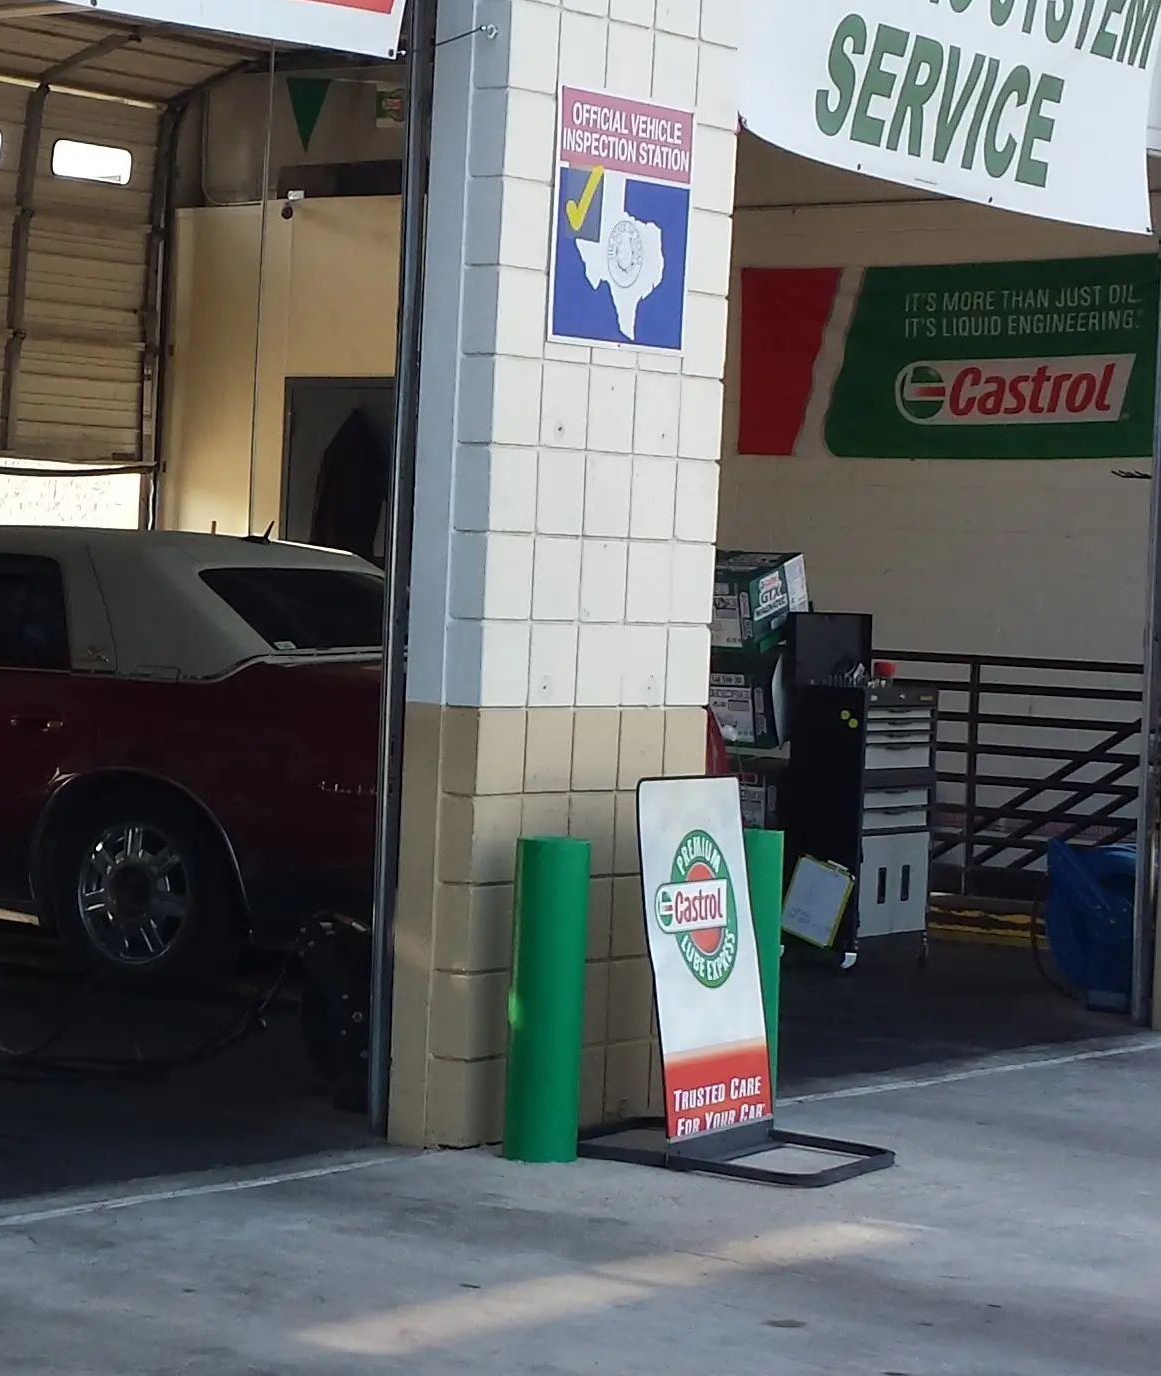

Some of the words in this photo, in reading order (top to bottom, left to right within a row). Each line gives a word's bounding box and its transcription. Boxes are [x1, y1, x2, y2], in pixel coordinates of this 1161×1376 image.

[815, 14, 1065, 188] SERVICE
[572, 102, 629, 135] OFFICIAL
[631, 113, 682, 145] VEHICLE
[563, 127, 636, 163] INSPECTION
[639, 143, 689, 172] STATION
[905, 292, 937, 312] IT'S
[942, 291, 995, 312] MORE
[1001, 288, 1049, 309] THAN
[1055, 285, 1102, 307] JUST
[905, 317, 936, 338] IT'S
[942, 315, 1001, 337] LIQUID
[949, 363, 1116, 416] Castrol
[676, 836, 721, 875] PREMIUM
[675, 888, 723, 924] Castrol
[681, 934, 706, 977] LUBE
[706, 928, 735, 981] EXPRESS
[673, 1083, 726, 1112] TRUSTED
[730, 1076, 762, 1100] CARE
[677, 1117, 700, 1136] FOR
[705, 1109, 736, 1130] YOUR
